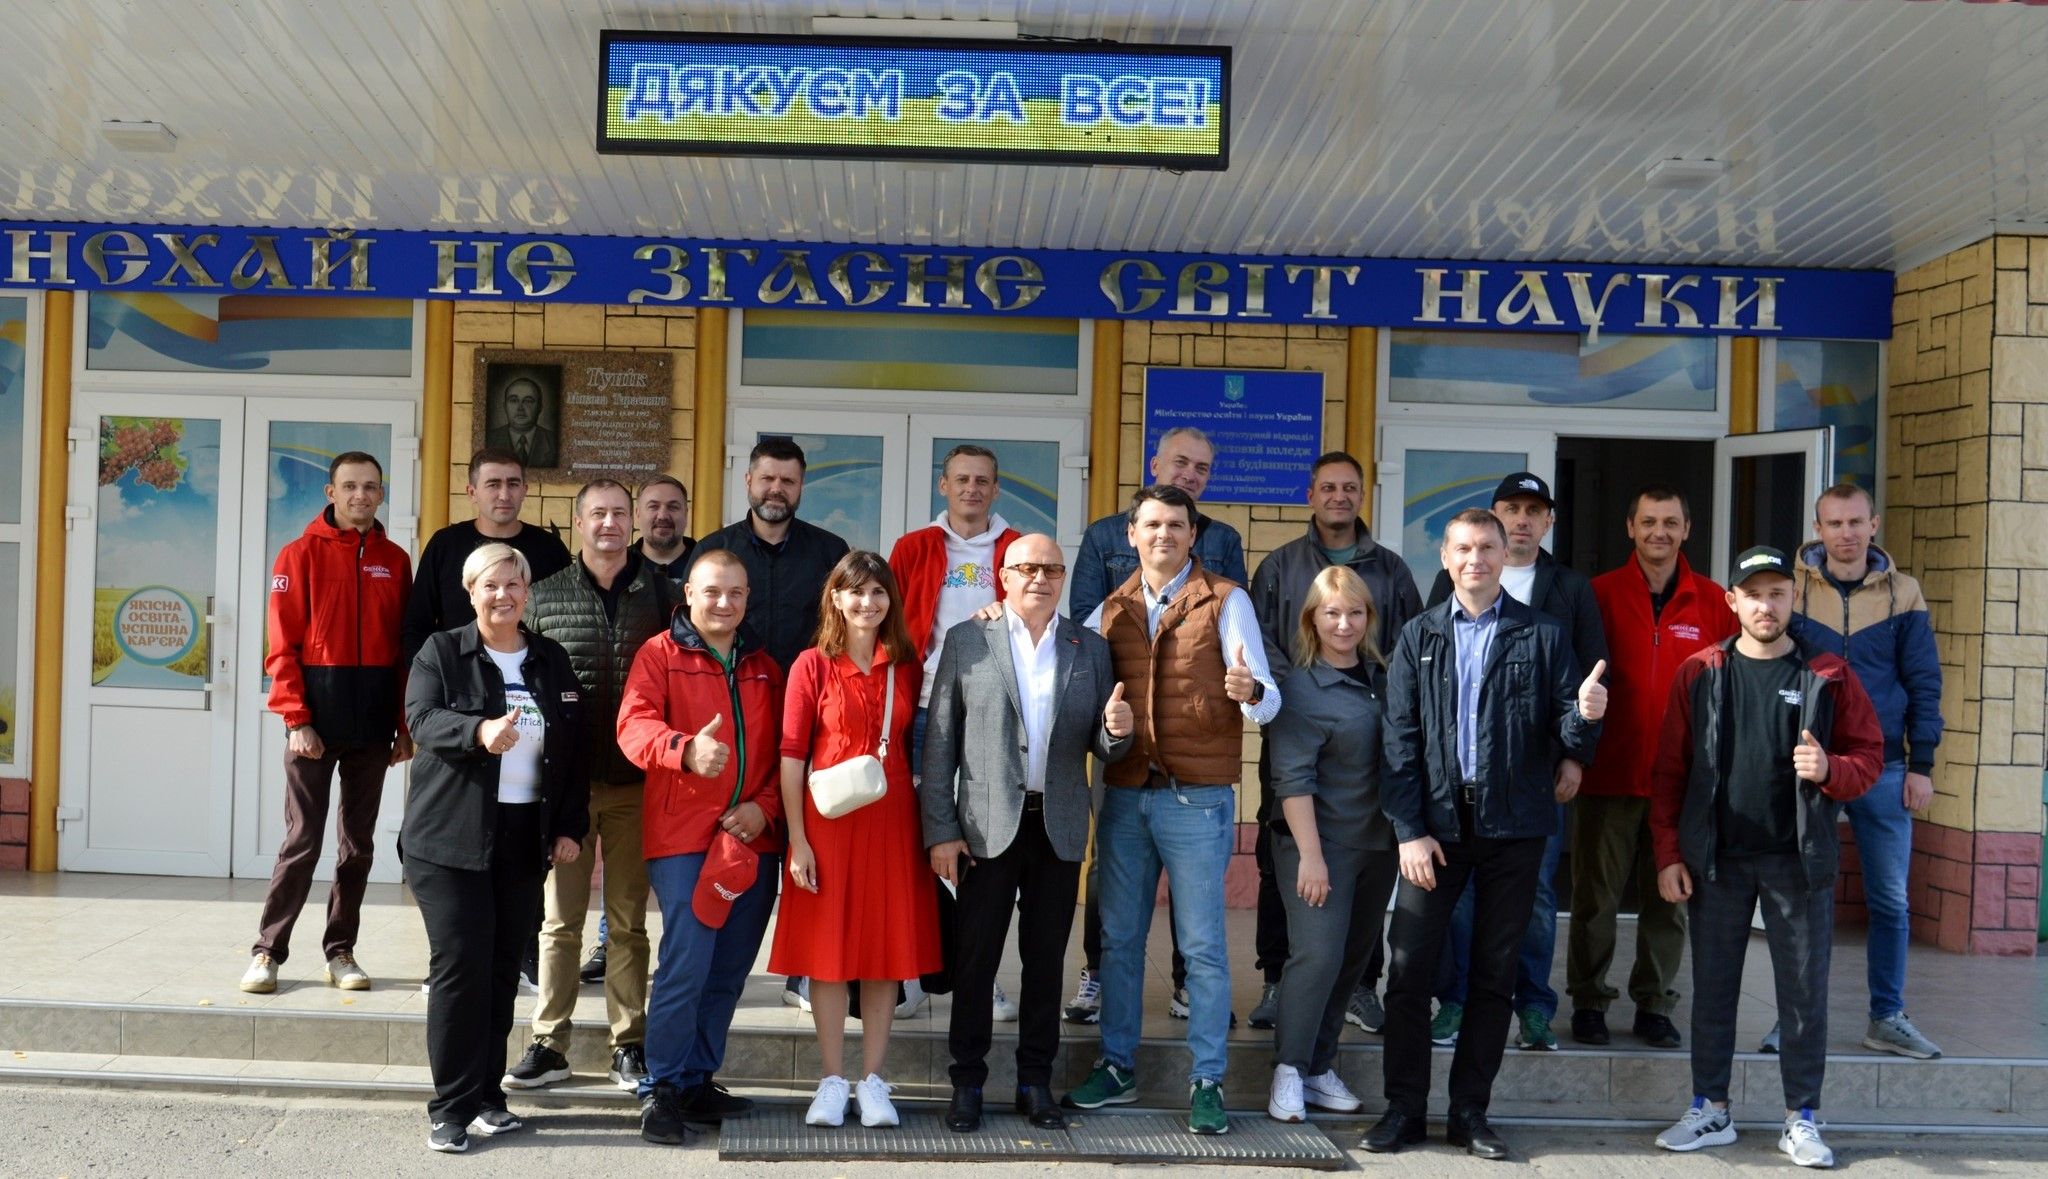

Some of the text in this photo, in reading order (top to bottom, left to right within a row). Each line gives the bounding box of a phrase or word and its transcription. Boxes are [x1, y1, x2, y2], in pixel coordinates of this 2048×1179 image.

[623, 62, 1211, 128] ДЯКУЄМ ЗА ВСЕ!
[4, 228, 1785, 344] НЕХАЙ НЕ ЗГАСНЕ СВІТ НАУКИ
[1153, 408, 1212, 419] Міністерство
[1213, 411, 1242, 419] освіти
[1248, 413, 1275, 421] науки
[1275, 412, 1313, 422] України
[1265, 445, 1313, 457] коледж
[129, 600, 182, 611] ЯКІСНА
[121, 623, 188, 636] УСПІШНА
[127, 635, 185, 648] КАР'ЄРА
